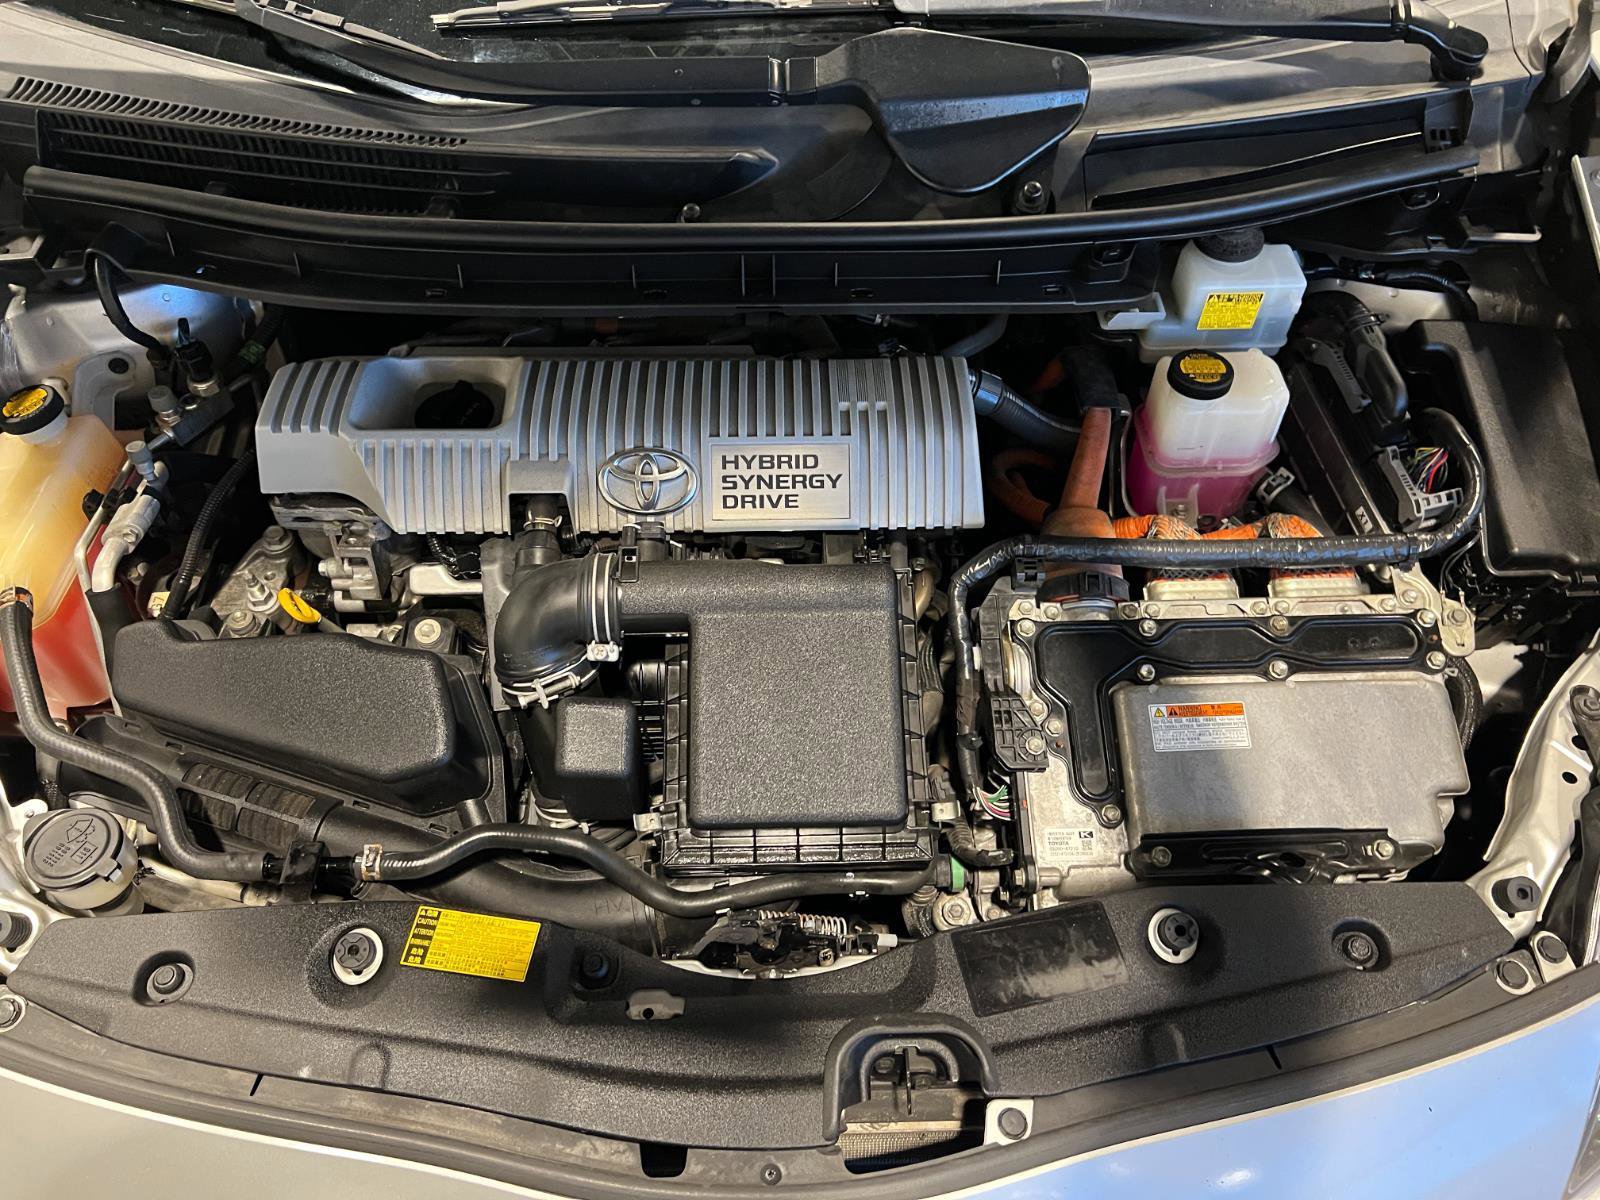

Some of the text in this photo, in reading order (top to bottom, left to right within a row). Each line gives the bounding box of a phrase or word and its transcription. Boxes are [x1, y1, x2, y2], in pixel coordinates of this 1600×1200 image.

[721, 454, 819, 470] HYBRID
[721, 473, 843, 490] SYNERGY
[722, 494, 800, 509] DRIVE
